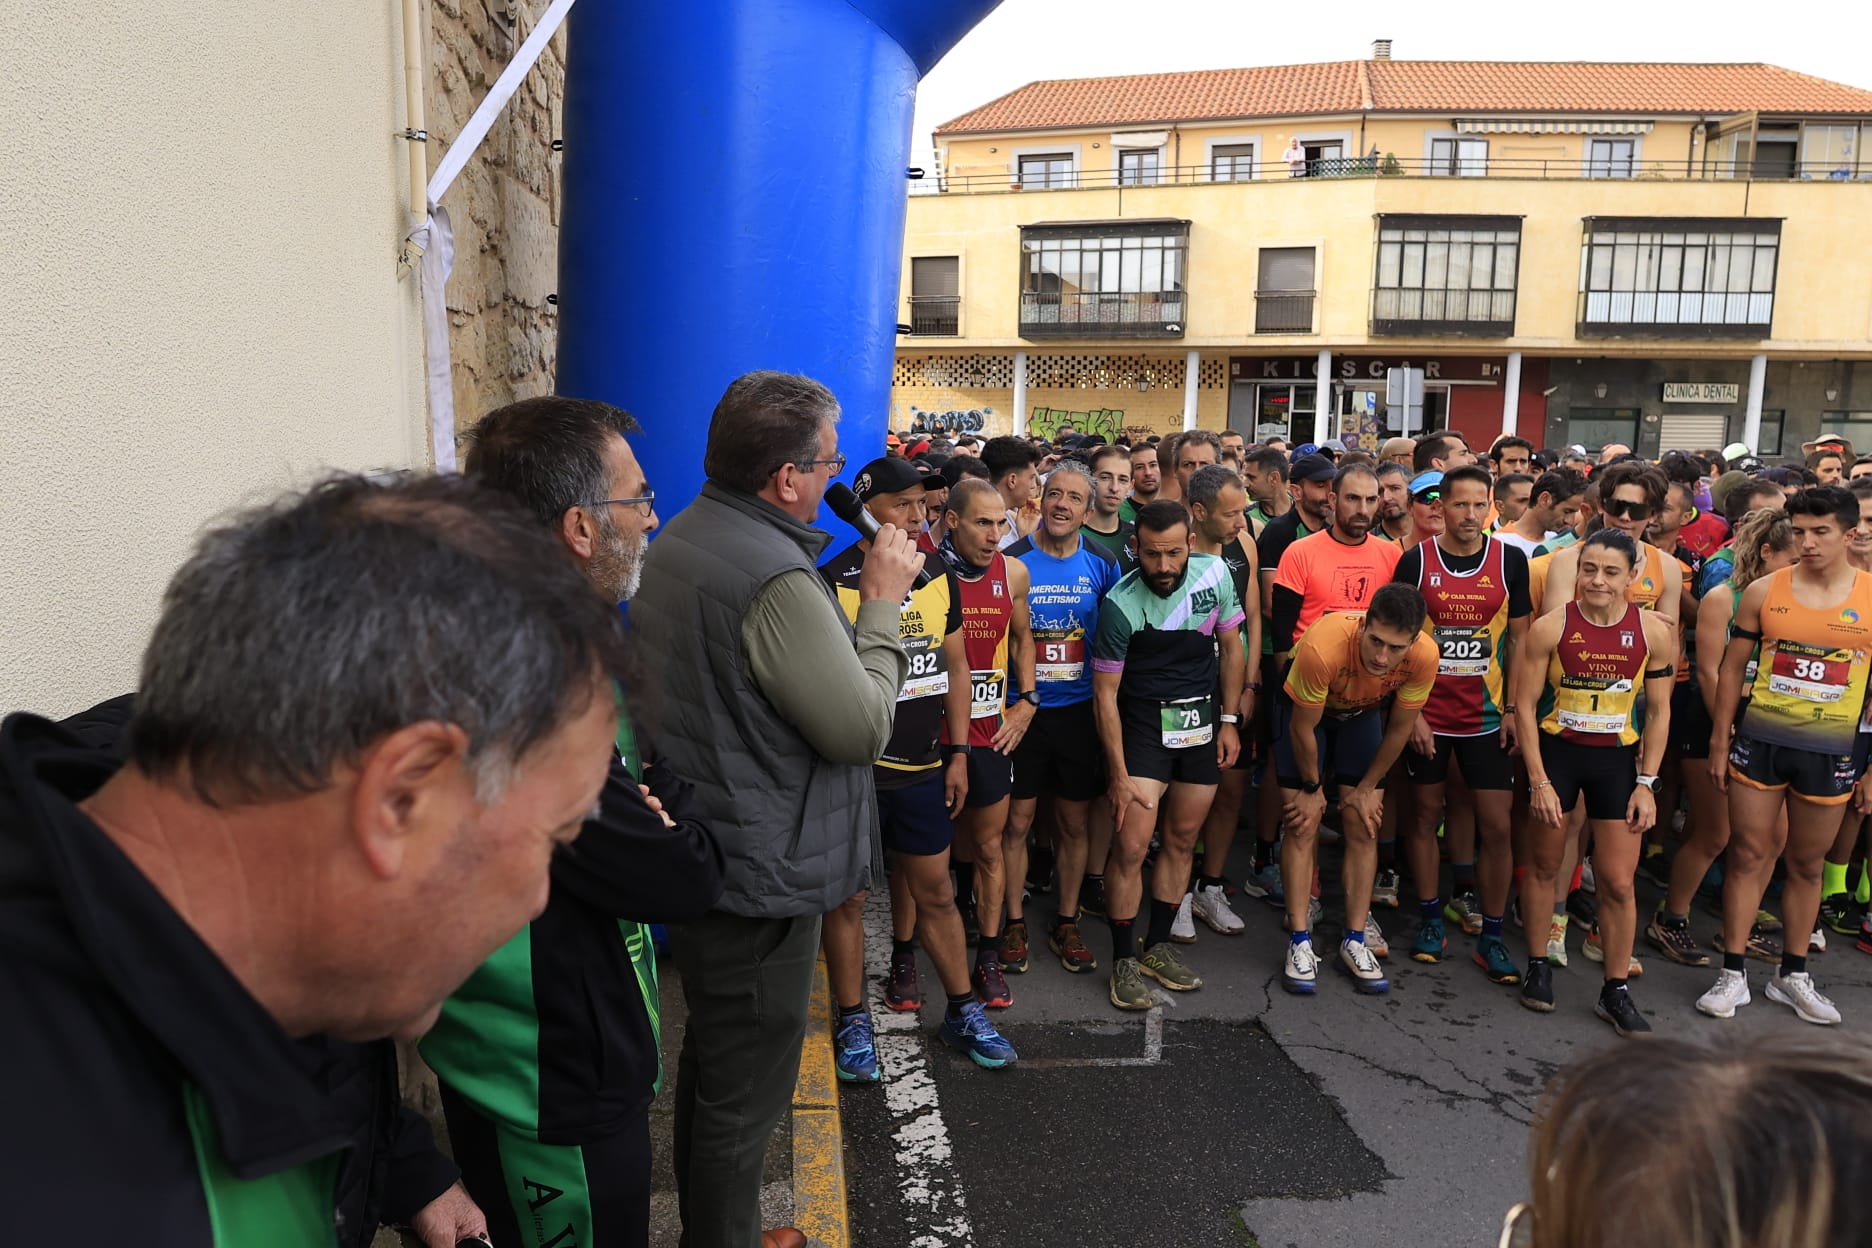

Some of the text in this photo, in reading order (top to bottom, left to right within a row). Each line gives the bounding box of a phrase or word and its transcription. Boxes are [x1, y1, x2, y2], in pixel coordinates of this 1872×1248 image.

[1665, 384, 1737, 399] CLINICA DENTAL
[1028, 584, 1092, 594] MERCIAL ULSA
[1031, 595, 1081, 605] ATLETISMO
[961, 607, 979, 615] CAJA
[1448, 604, 1475, 612] VINO
[1440, 612, 1483, 621] DE TORO
[899, 623, 924, 636] ROSS
[963, 620, 989, 629] VINO
[968, 630, 997, 639] TORO
[910, 640, 928, 648] CROSS
[1443, 640, 1482, 658] 202
[1045, 643, 1066, 662] 51
[1804, 647, 1825, 656] CROSS
[907, 652, 938, 676] 82
[1438, 664, 1488, 673] OMISAG
[1588, 663, 1617, 672] VINO
[1035, 669, 1082, 678] OMISAGA
[1793, 658, 1826, 681] 38
[1594, 672, 1625, 680] TORO
[1569, 679, 1583, 687] LIGA
[1587, 681, 1607, 689] CROSS
[899, 681, 948, 698] MISAGA
[971, 682, 998, 702] 09
[1590, 694, 1599, 712] 1
[1180, 708, 1201, 728] 79
[1560, 717, 1623, 730] JOMISAGA
